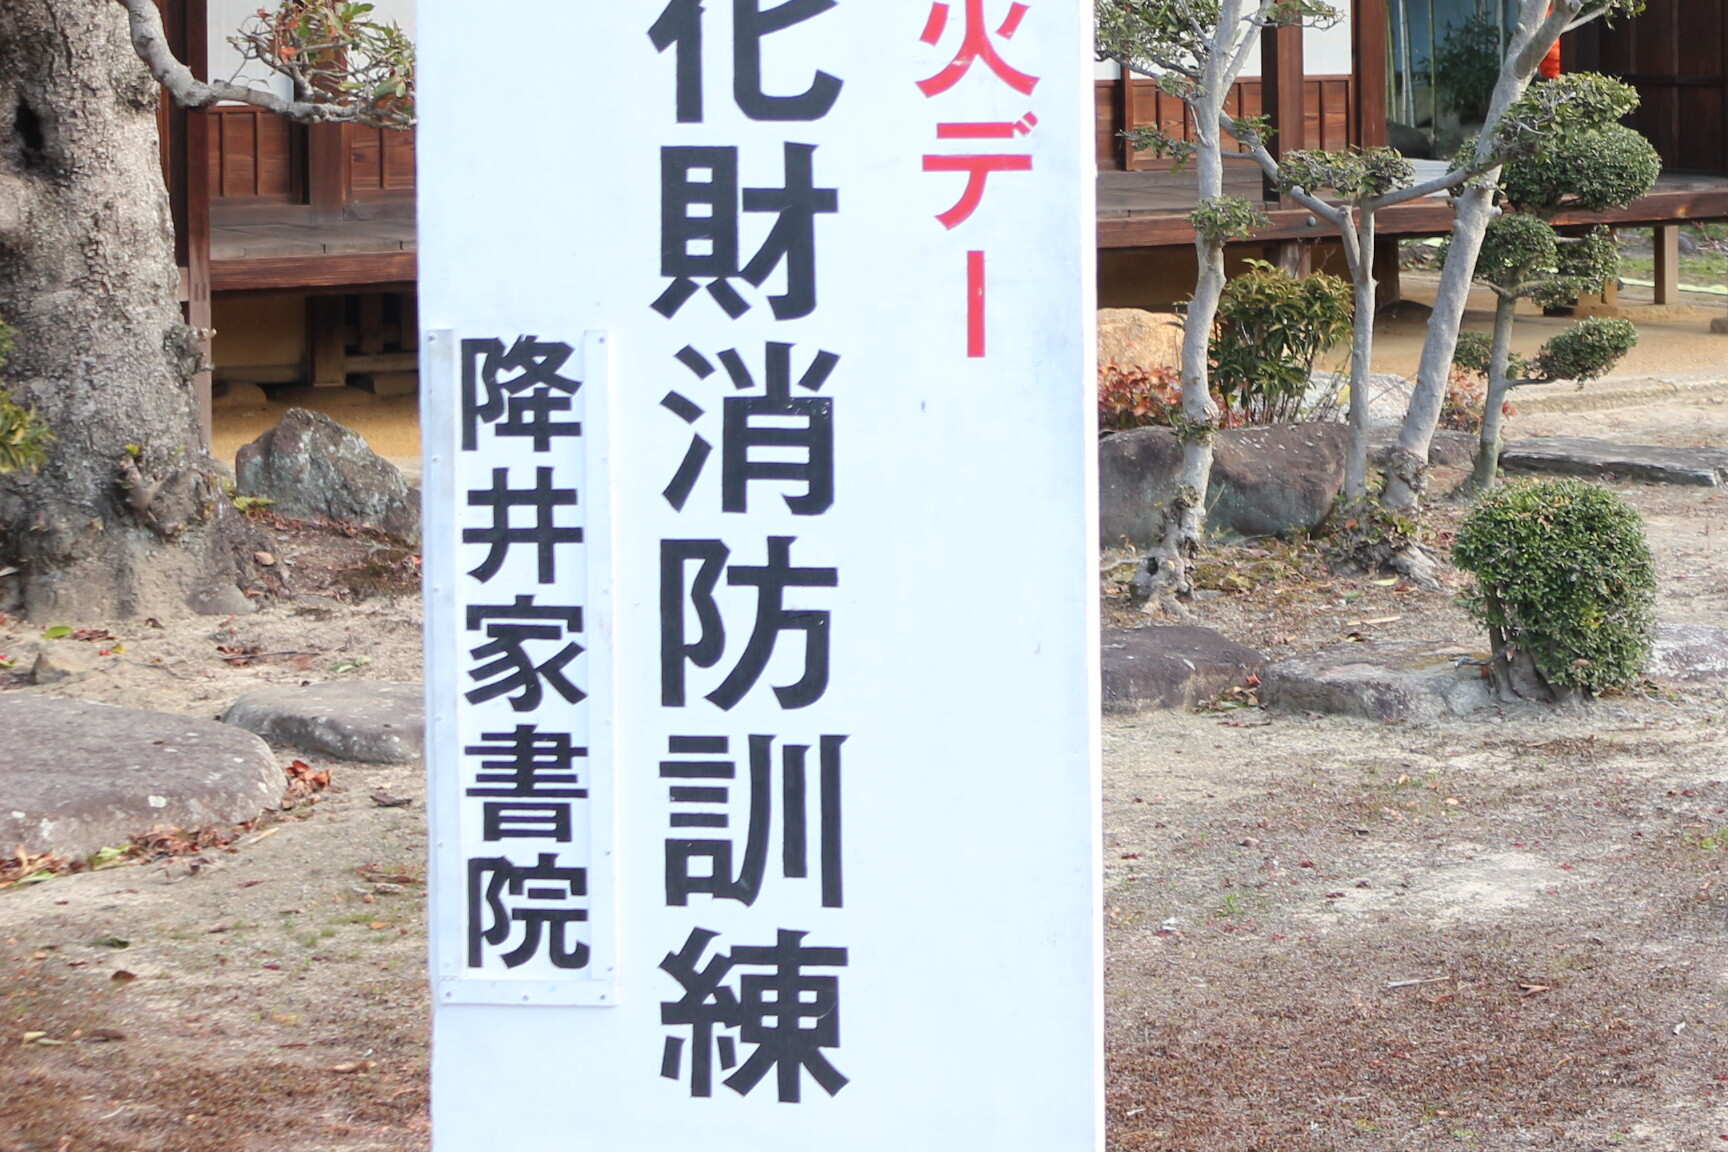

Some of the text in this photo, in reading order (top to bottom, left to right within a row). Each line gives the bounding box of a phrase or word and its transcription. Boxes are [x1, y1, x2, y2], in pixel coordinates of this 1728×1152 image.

[460, 333, 590, 970] 降井家書院
